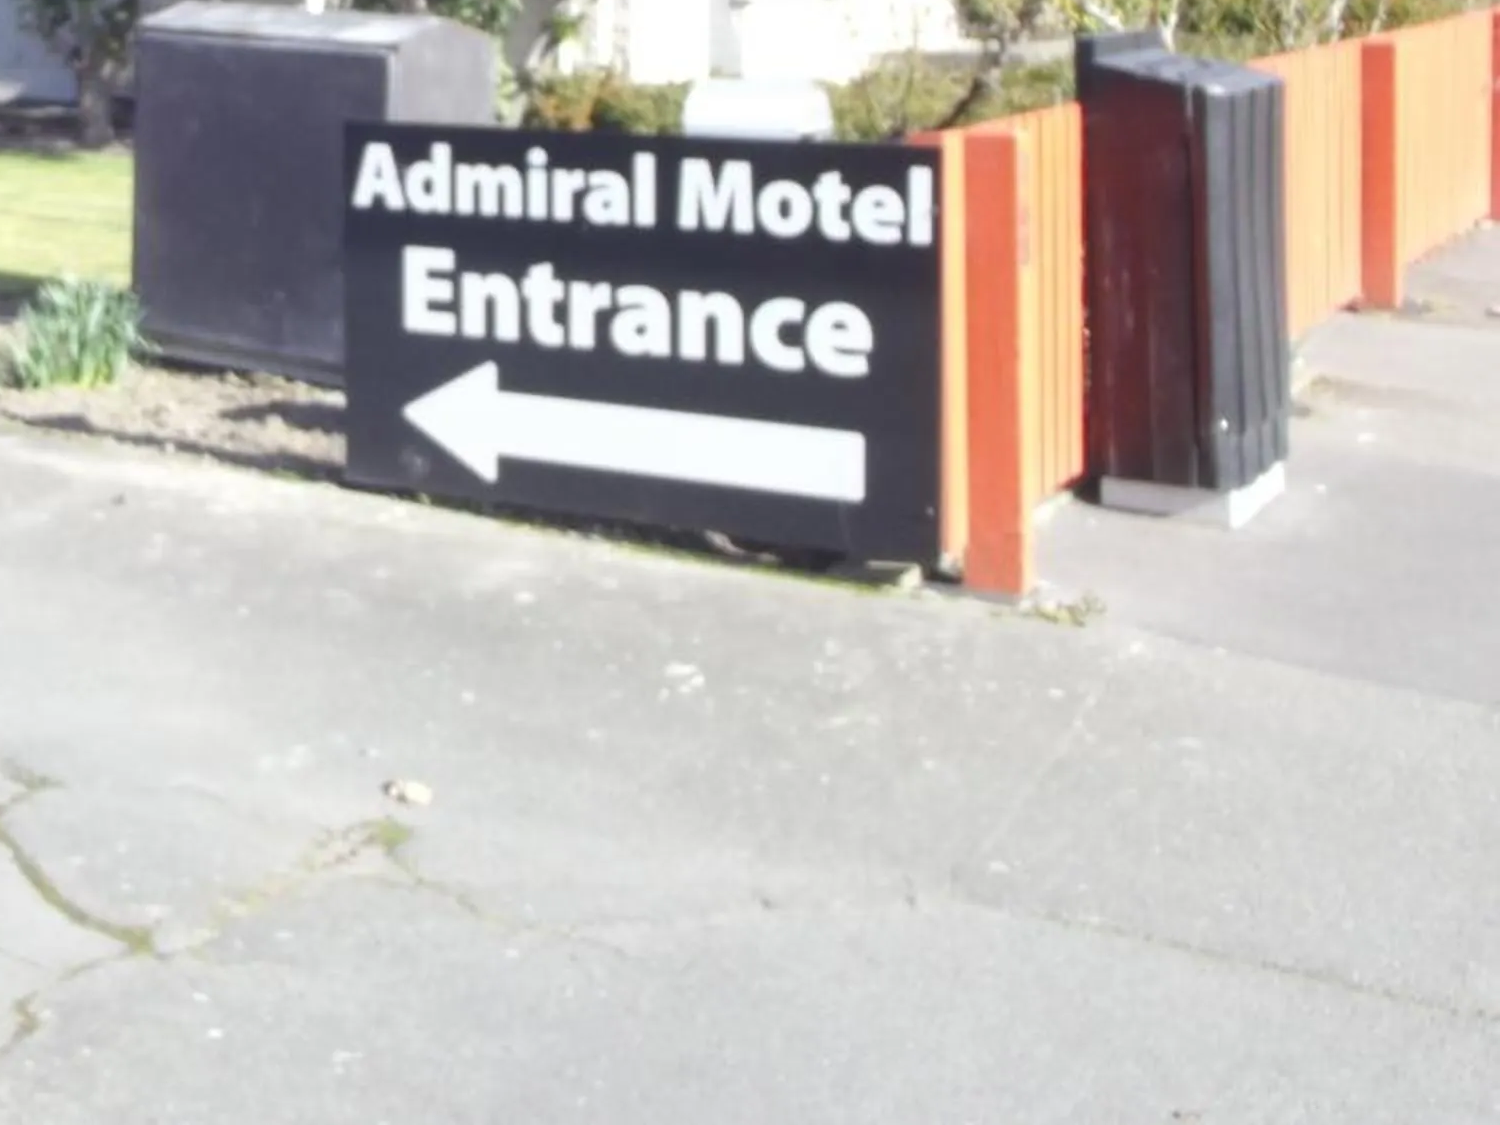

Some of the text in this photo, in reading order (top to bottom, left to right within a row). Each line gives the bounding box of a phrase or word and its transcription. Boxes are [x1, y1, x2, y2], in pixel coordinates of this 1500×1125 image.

[352, 141, 934, 246] Admiral Motel
[402, 245, 874, 376] Entrance
